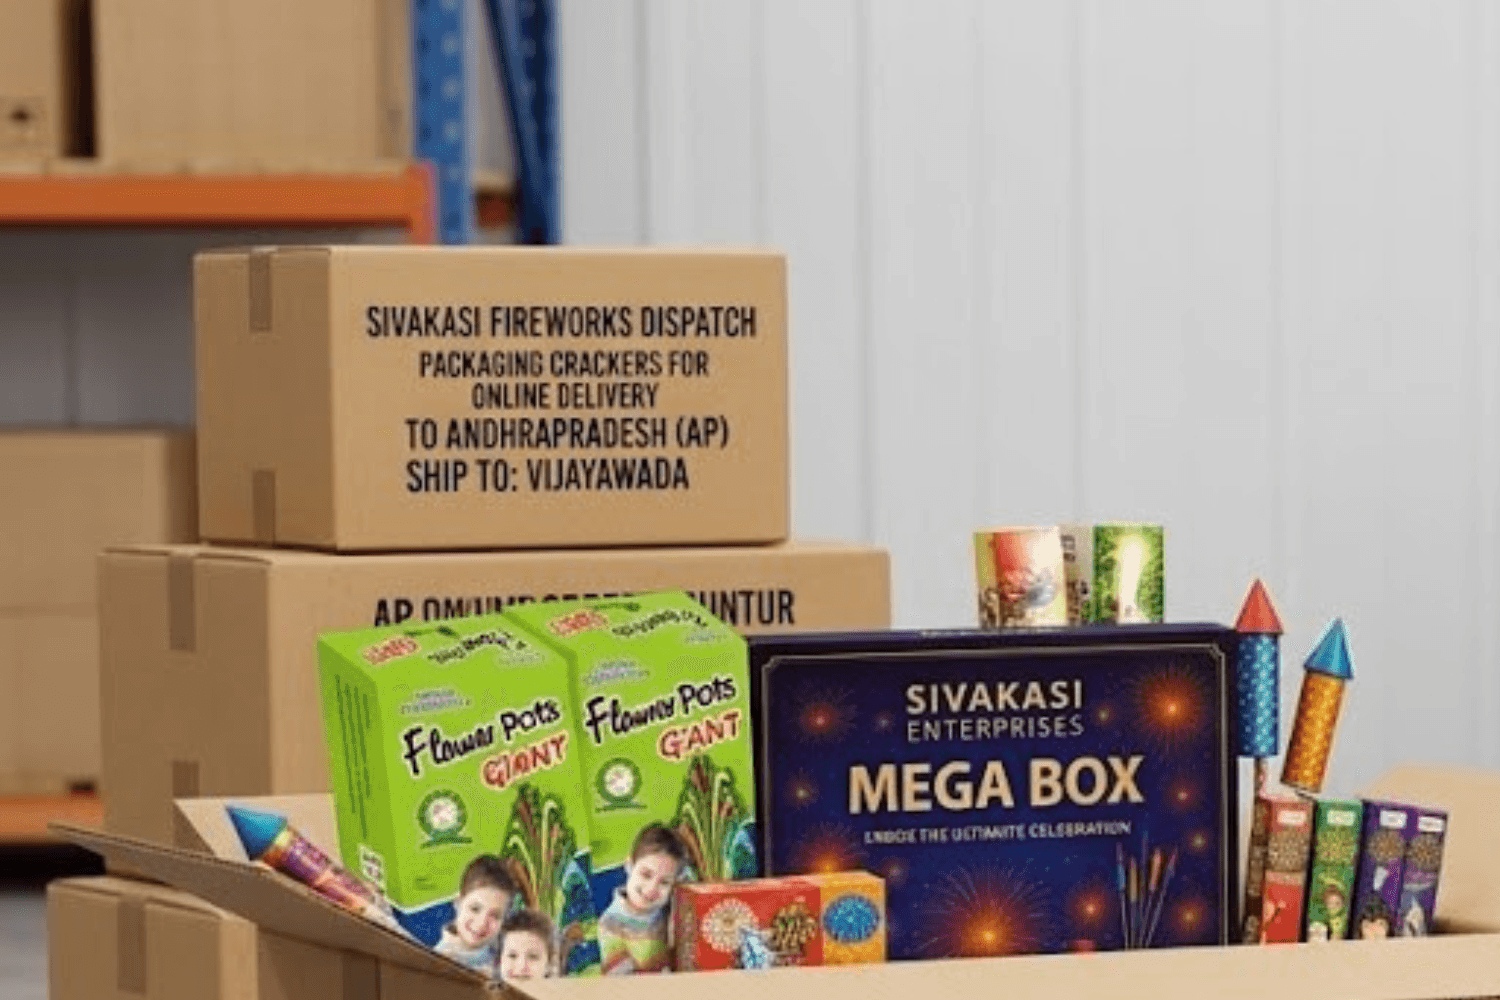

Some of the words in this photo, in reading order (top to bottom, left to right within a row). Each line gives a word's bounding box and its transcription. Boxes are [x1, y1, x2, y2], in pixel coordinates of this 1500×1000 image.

[366, 306, 481, 338] SIVAKASI
[490, 306, 633, 338] FIREWORKS
[640, 305, 757, 338] DISPATCH
[419, 350, 543, 378] PACKAGING
[550, 350, 662, 378] CRACKERS
[668, 350, 710, 377] FOR
[471, 382, 551, 409] ONLINE
[557, 382, 659, 409] DELIVERY
[406, 418, 438, 450] TO
[446, 417, 668, 450] ANDHRAPRADESH
[675, 414, 730, 449] (AP)
[406, 459, 468, 493] SHIP
[475, 459, 518, 493] TO:
[526, 457, 690, 491] VIJAYAWADA
[905, 679, 1084, 714] SIVAKASI
[906, 715, 1085, 743] ENTERPRISES
[848, 762, 1014, 815] MEGA
[1028, 754, 1145, 807] BOX
